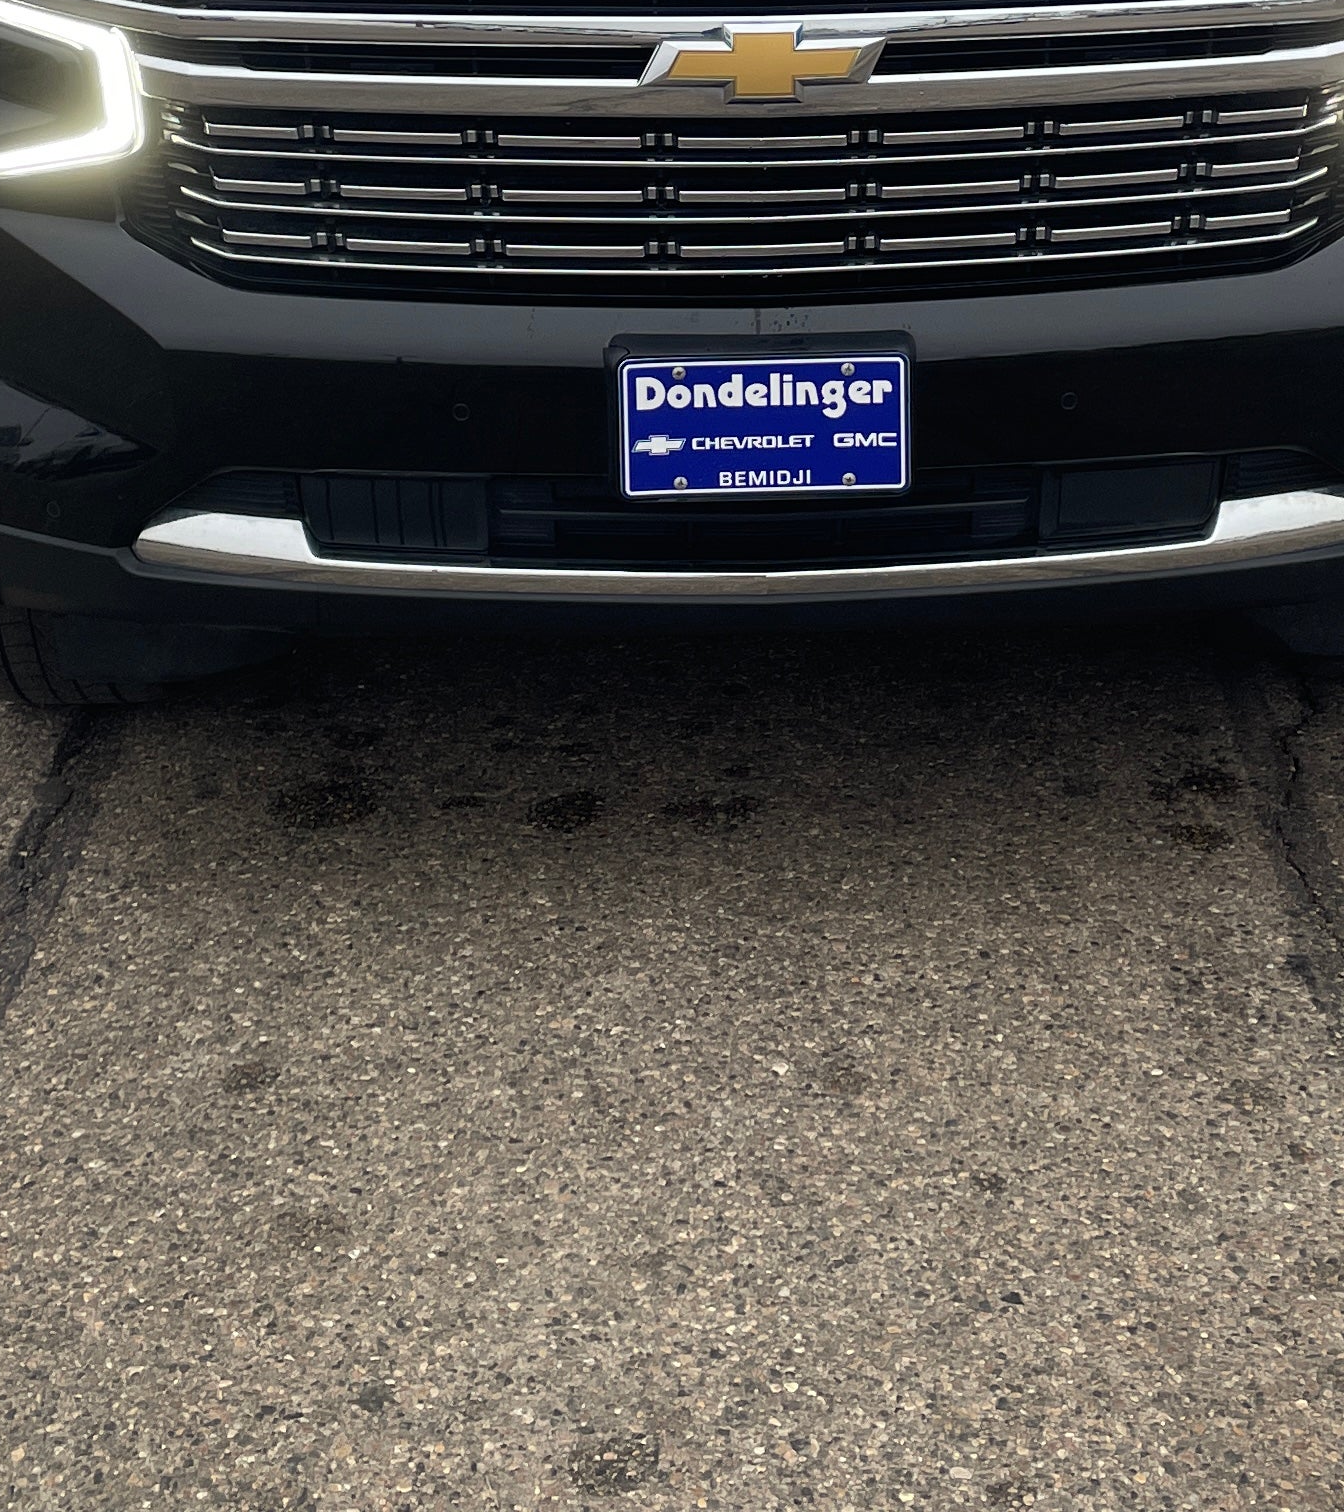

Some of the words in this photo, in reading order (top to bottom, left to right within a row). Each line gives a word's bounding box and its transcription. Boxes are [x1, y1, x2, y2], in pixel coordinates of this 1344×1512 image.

[635, 372, 893, 419] Dondelinger
[691, 434, 815, 451] CHEVROLET
[833, 432, 898, 448] GMC
[719, 469, 812, 486] BEMIDJI
